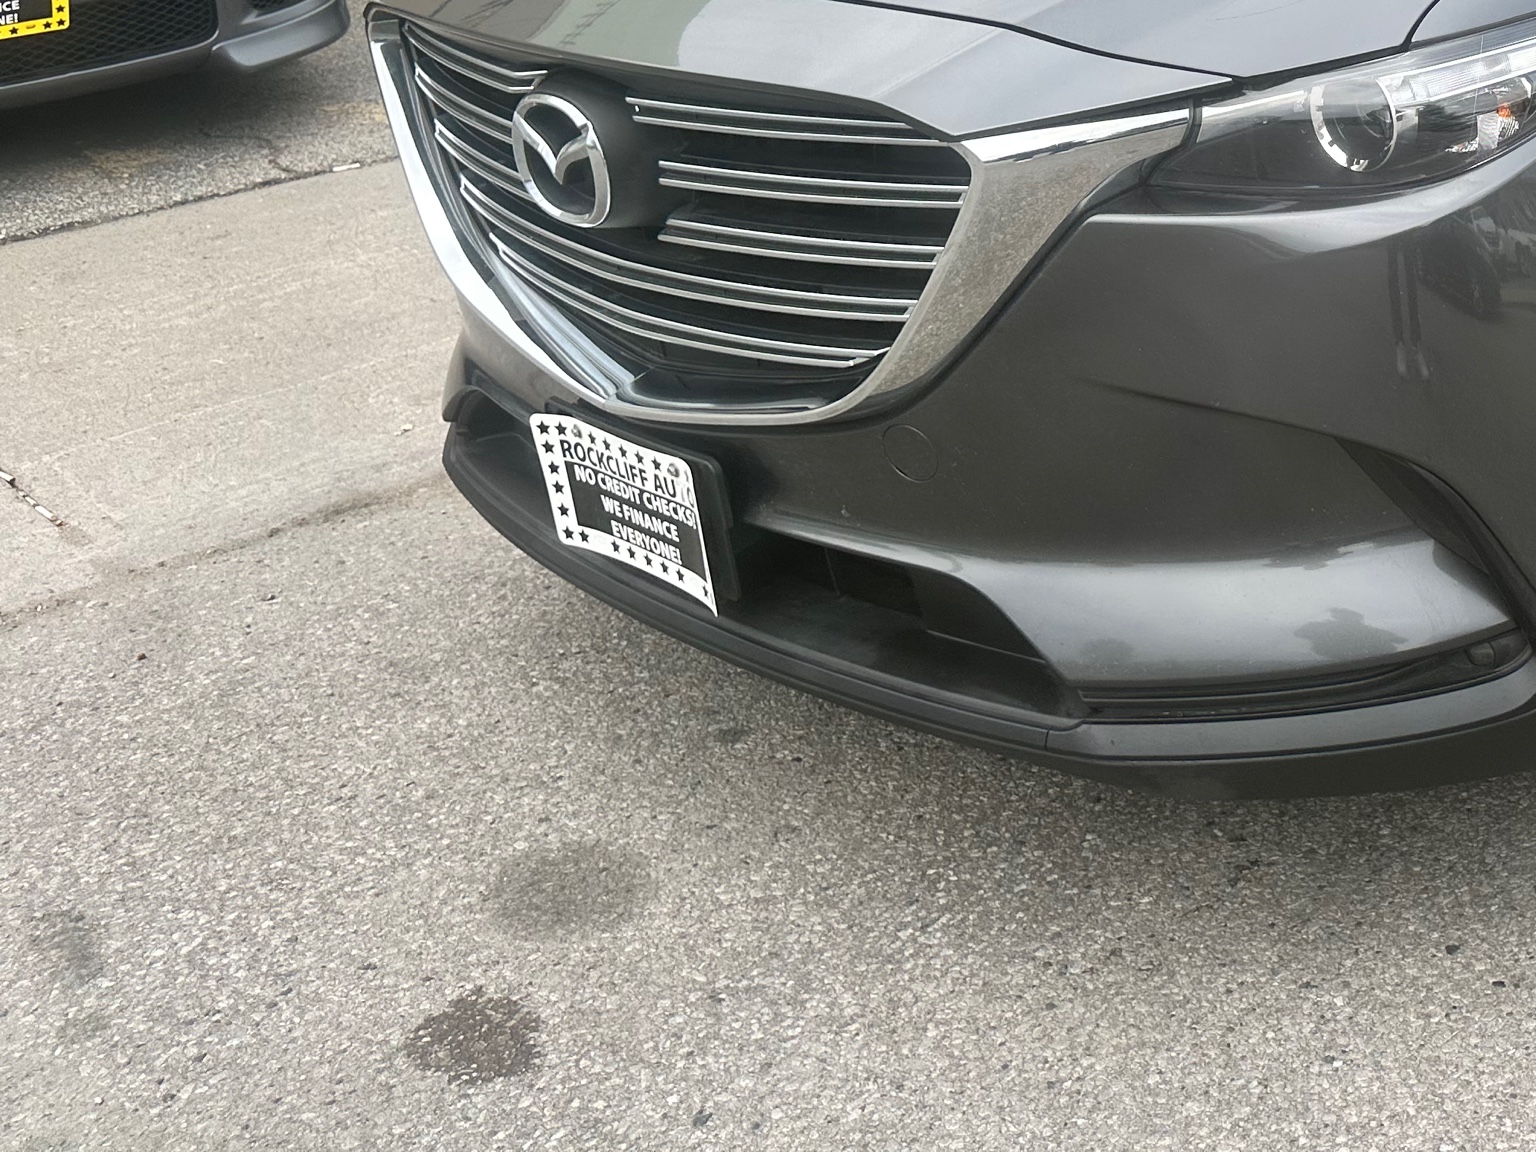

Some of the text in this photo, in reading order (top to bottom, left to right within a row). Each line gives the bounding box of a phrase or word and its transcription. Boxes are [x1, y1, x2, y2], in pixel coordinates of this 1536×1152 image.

[559, 439, 649, 488] ROCKCLIFF
[575, 465, 696, 530] NO CREDIT CHECKS!
[600, 494, 680, 543] WE FINANCE
[611, 520, 682, 565] EVERYONE!
